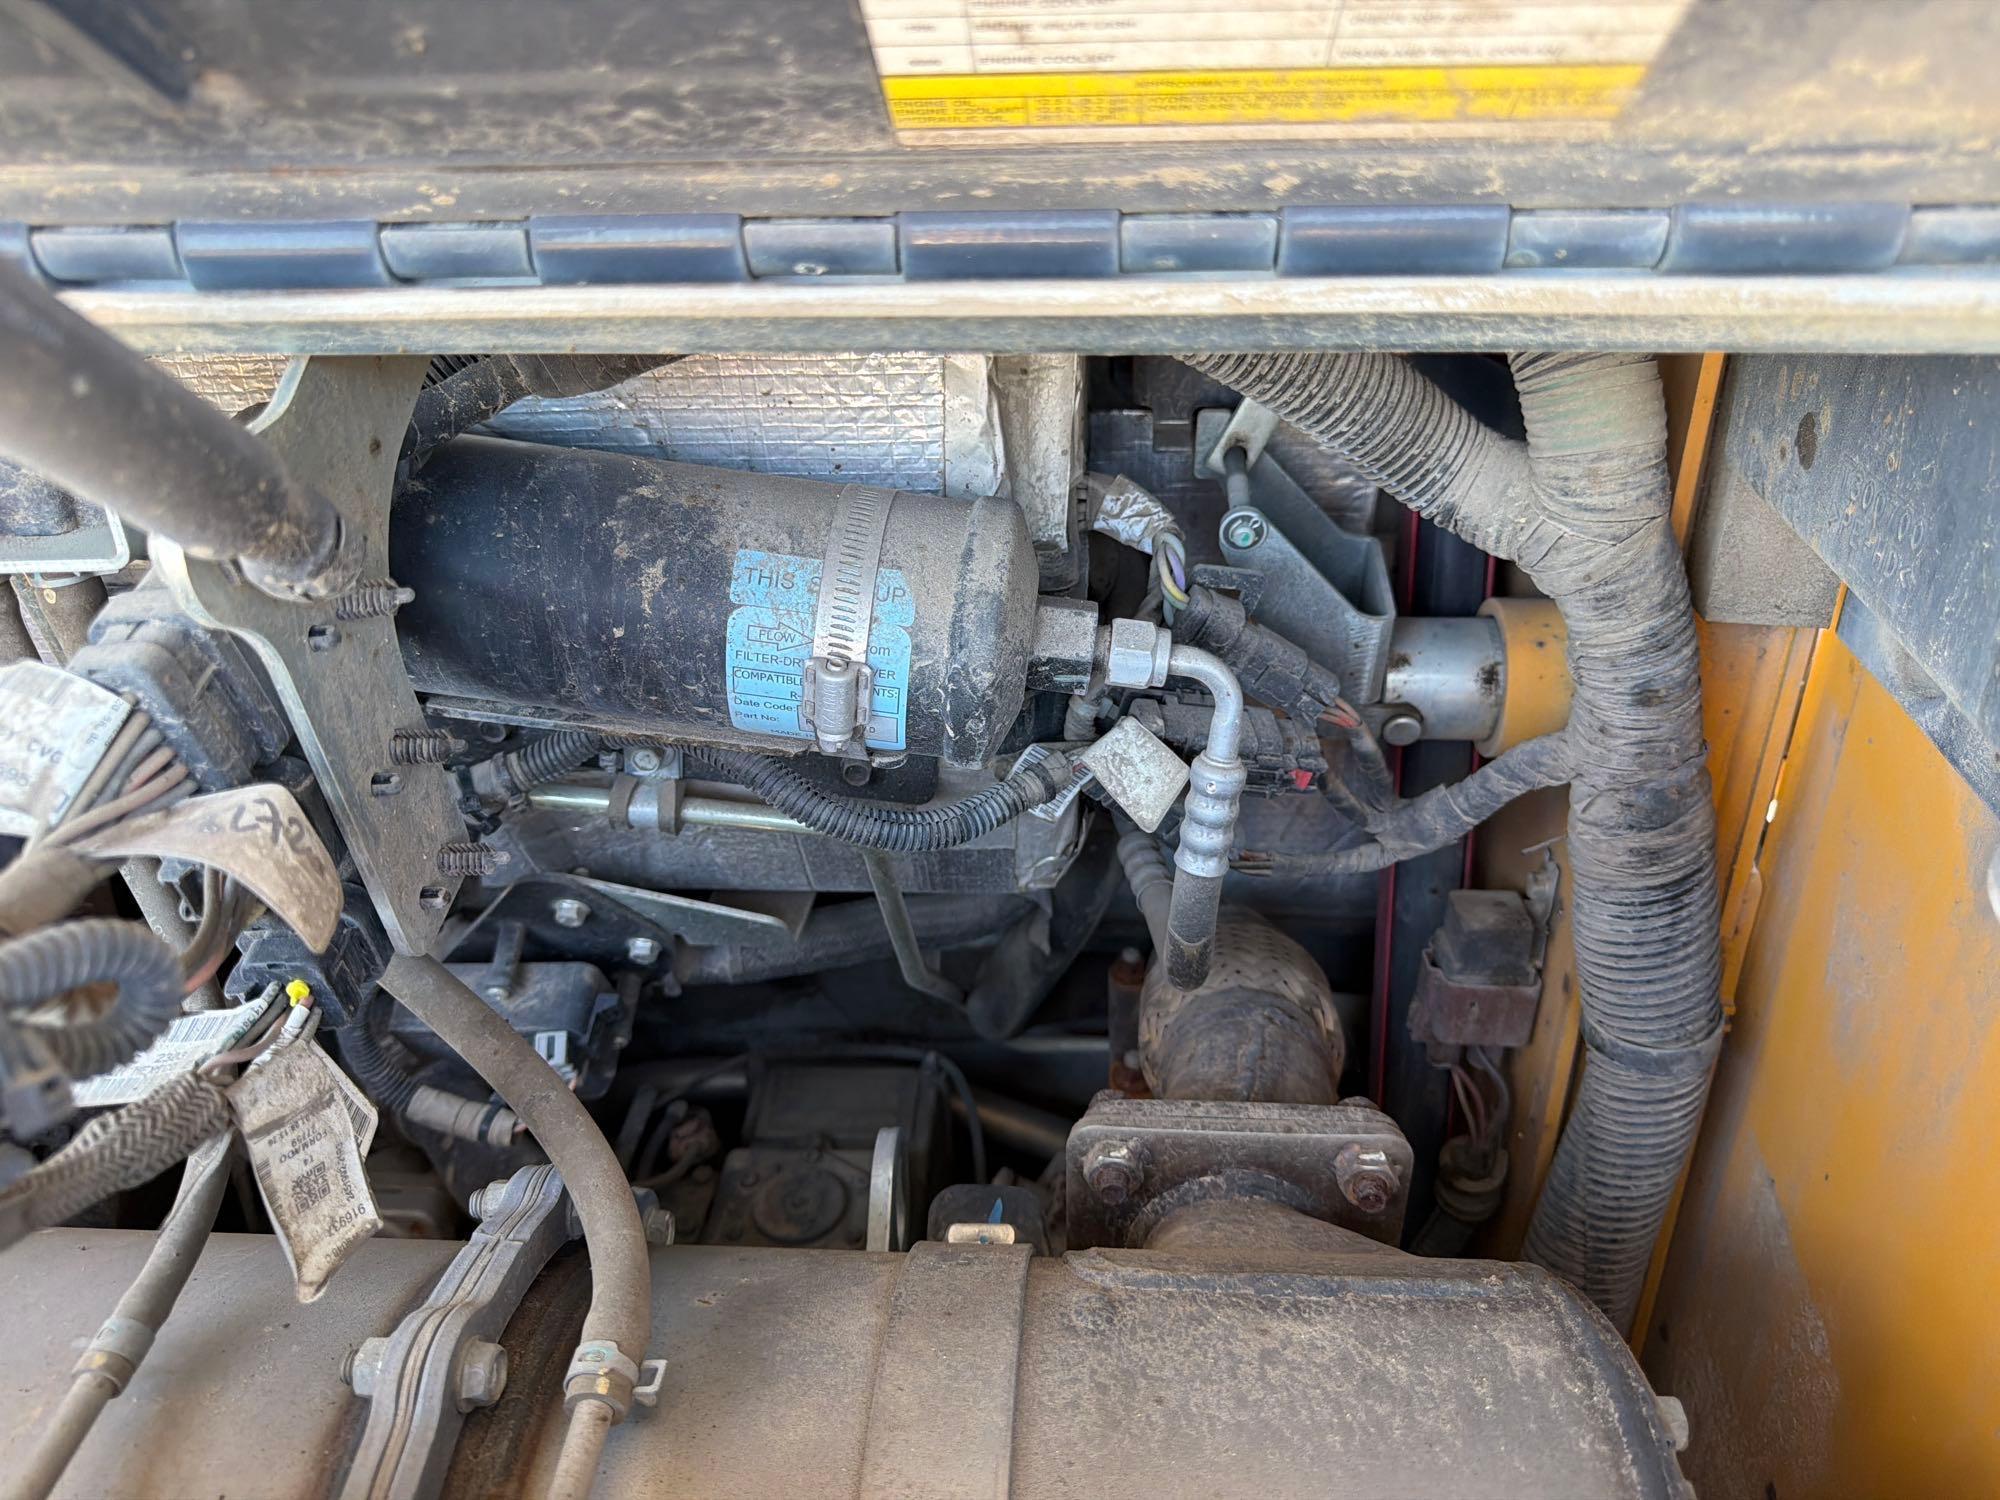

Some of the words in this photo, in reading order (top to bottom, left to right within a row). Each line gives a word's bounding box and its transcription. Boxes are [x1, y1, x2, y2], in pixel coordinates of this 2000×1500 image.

[979, 56, 1037, 65] ENGINE
[1041, 54, 1116, 64] COOLANT
[953, 100, 976, 108] OIL
[896, 108, 948, 116] ENGINE
[953, 107, 1025, 115] COOLANT
[984, 115, 1009, 123] OIL
[745, 566, 796, 591] THIS
[876, 586, 907, 602] UP
[758, 629, 796, 644] FLOW
[734, 696, 760, 708] Date
[763, 701, 797, 712] Code:
[735, 711, 759, 720] Part
[761, 714, 780, 722] No:
